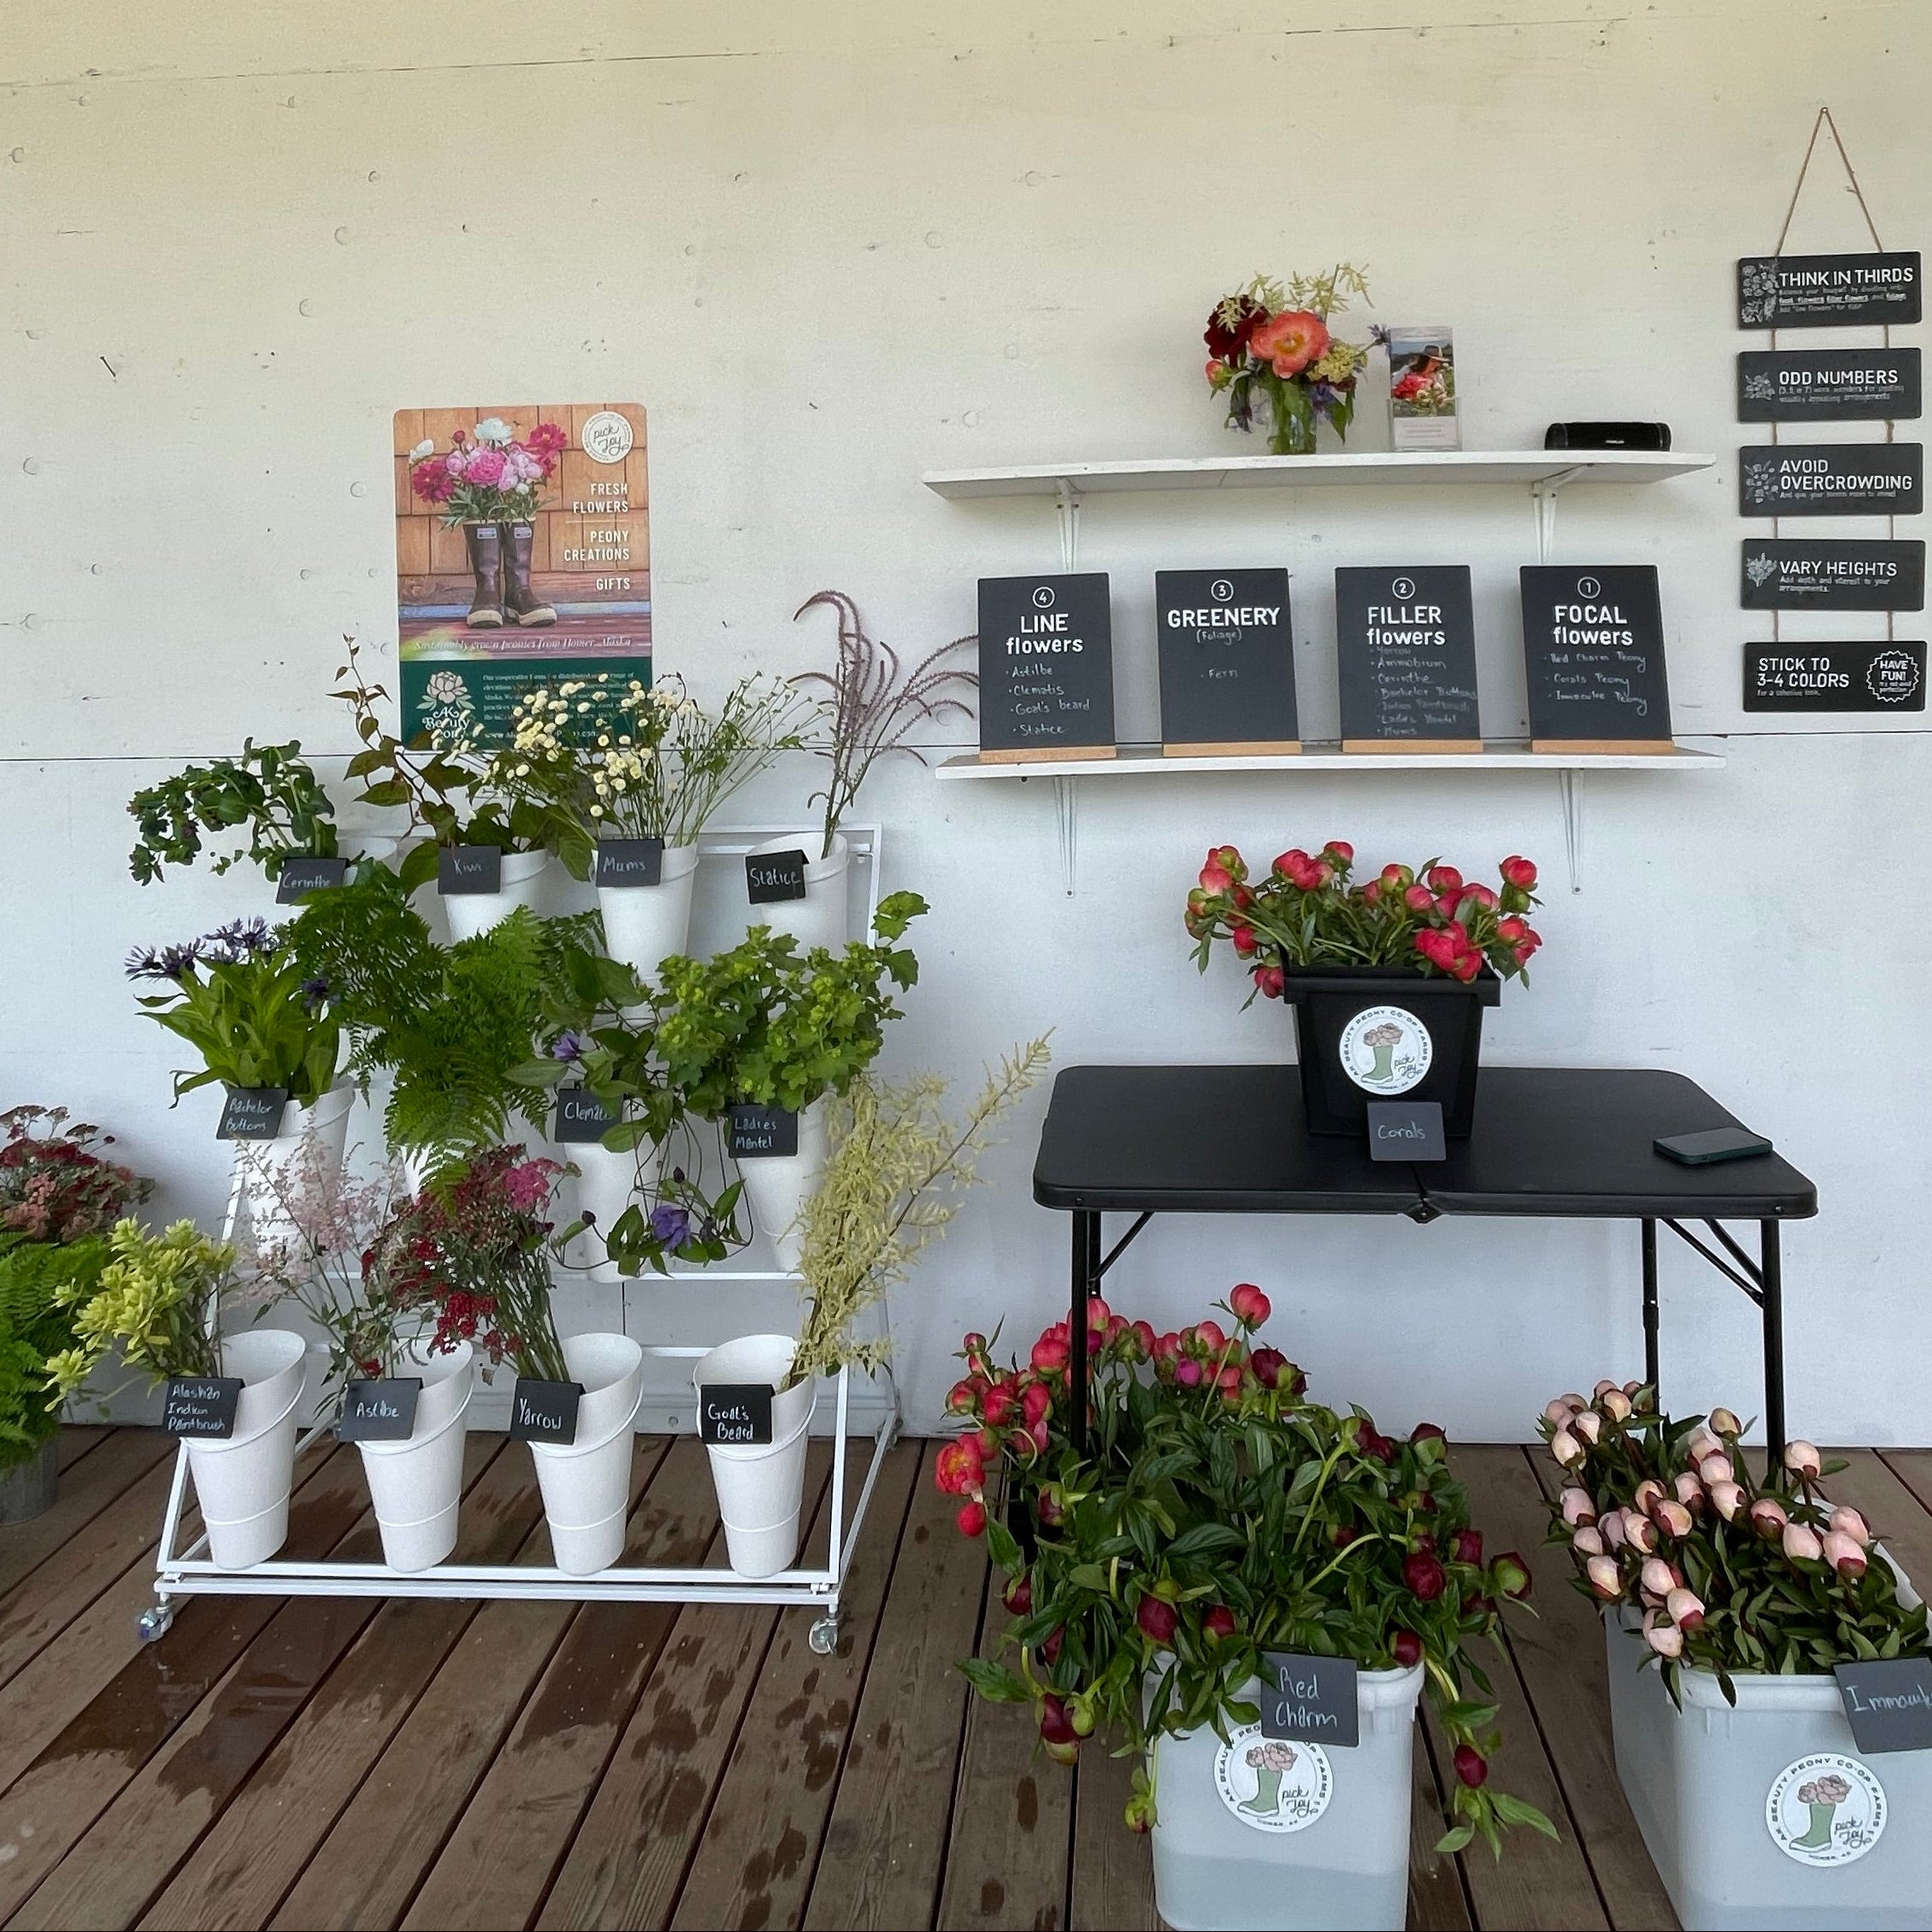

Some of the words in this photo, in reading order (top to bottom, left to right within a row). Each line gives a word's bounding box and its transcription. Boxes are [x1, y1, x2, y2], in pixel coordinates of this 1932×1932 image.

[1779, 272, 1829, 287] THINK
[1833, 270, 1851, 285] IN
[1855, 267, 1913, 284] THIRDS
[1779, 371, 1812, 385] ODD
[1817, 370, 1898, 384] NUMBERS
[1780, 459, 1829, 473] AVOID
[590, 483, 628, 496] FRESH
[1780, 475, 1912, 490] OVERCROWDING
[573, 501, 628, 513] FLOWERS
[590, 530, 628, 543] PEONY
[564, 548, 630, 562] CREATIONS
[1780, 560, 1822, 575] VARY
[1826, 561, 1897, 576] HEIGHTS
[596, 578, 630, 591] GIFTS
[1218, 585, 1226, 596] 3
[1400, 582, 1407, 593] 2
[1039, 592, 1047, 604] 4
[1020, 613, 1069, 633] LINE
[1167, 607, 1280, 628] GREENERY
[1367, 605, 1442, 625] FILLER
[1554, 605, 1627, 624] FOCAL
[1367, 628, 1446, 645] flowers
[1553, 627, 1633, 645] flowers
[1006, 637, 1084, 655] flowers
[1012, 662, 1052, 678] Astilbe
[1551, 653, 1568, 663] Red
[1617, 651, 1646, 674] Peony
[1758, 657, 1805, 671] STICK
[1811, 657, 1830, 671] TO
[1880, 660, 1908, 669] HAVE
[1208, 668, 1238, 679] Fern
[1757, 673, 1783, 687] 3-4
[1789, 673, 1849, 688] COLORS
[1881, 671, 1906, 681] FUN!
[1014, 684, 1064, 696] Clematis
[1554, 673, 1587, 684] Corals
[1595, 673, 1630, 698] Peony
[1016, 701, 1050, 715] Goat's
[1058, 698, 1090, 711] beard
[1614, 691, 1647, 716] Peony
[433, 706, 460, 719] AK
[421, 716, 470, 731] Beuty
[603, 856, 646, 873] Mums
[750, 867, 800, 887] Statice
[1344, 1026, 1356, 1063] BEAUTY
[1356, 1010, 1385, 1025] PEONY
[229, 1097, 273, 1114] Bachelor
[226, 1117, 267, 1132] Buttons
[734, 1117, 777, 1130] Ladies
[1378, 1121, 1426, 1139] Corals
[172, 1384, 221, 1400] Alaskan
[168, 1402, 209, 1415] Indian
[519, 1397, 562, 1430] Yarrow
[708, 1403, 749, 1421] Goat's
[717, 1422, 754, 1441] Beard
[1279, 1665, 1321, 1700] Red
[1276, 1701, 1338, 1728] Charm
[1316, 1757, 1328, 1798] FARMS
[1281, 1785, 1310, 1803] pick
[1770, 1775, 1788, 1822] BEAUTY
[1791, 1757, 1832, 1774] PEONY
[1287, 1799, 1319, 1818] Joy
[1834, 1814, 1863, 1836] pick
